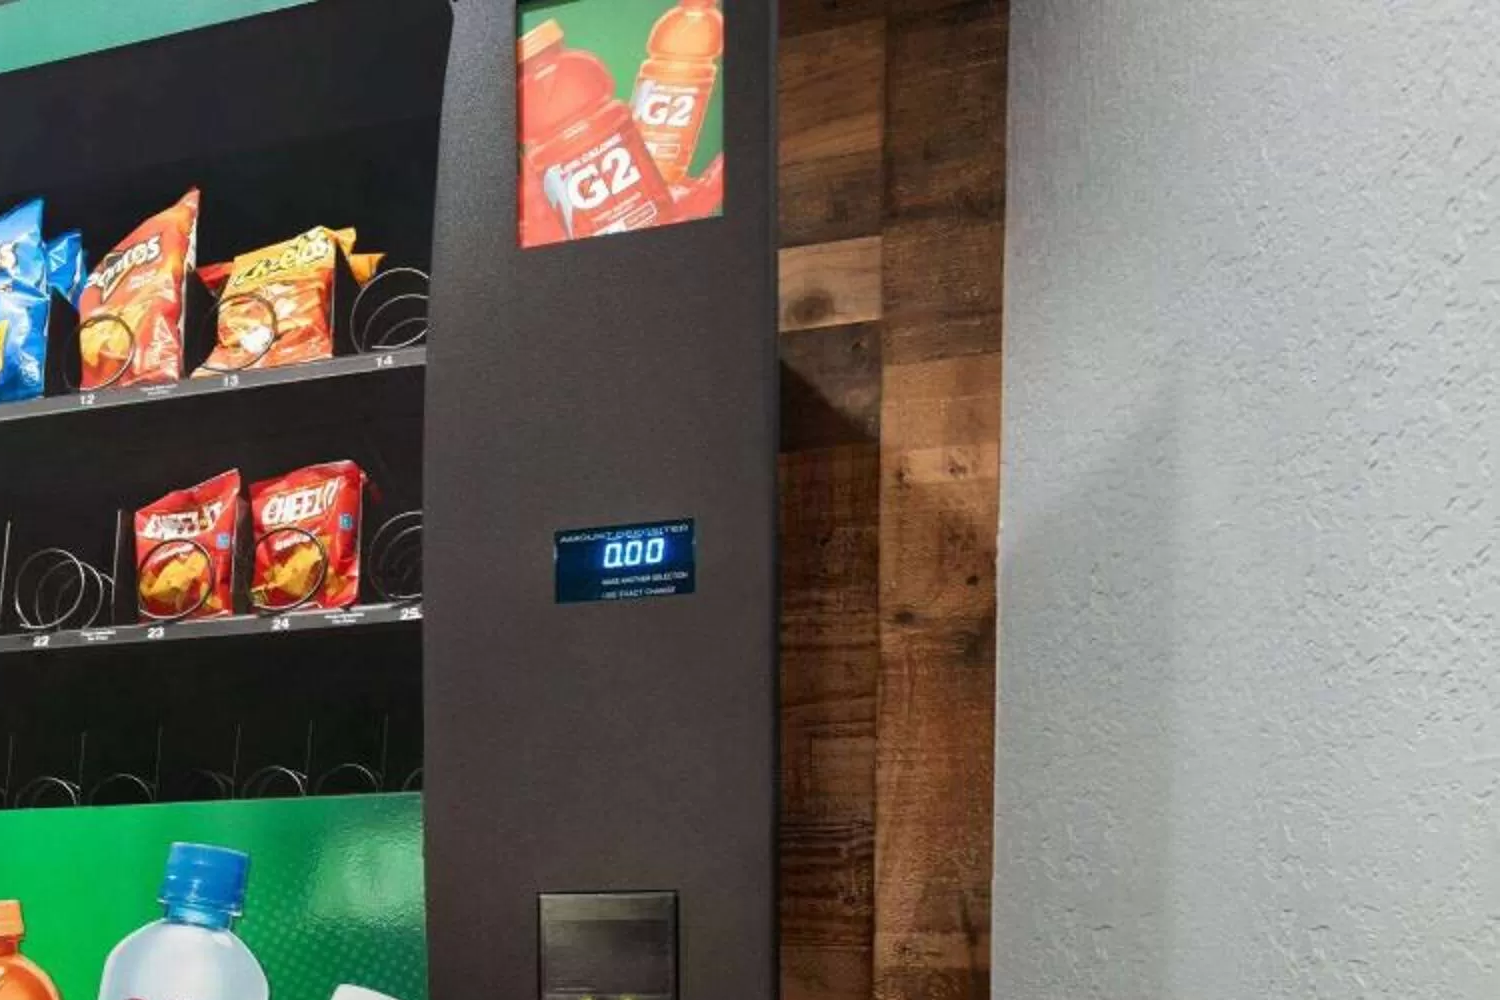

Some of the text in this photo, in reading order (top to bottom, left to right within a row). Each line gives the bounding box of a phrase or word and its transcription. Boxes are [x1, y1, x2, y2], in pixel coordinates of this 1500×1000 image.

[641, 94, 696, 126] G2
[567, 146, 642, 210] G2
[376, 355, 393, 367] 14
[223, 375, 238, 387] 13
[80, 394, 96, 405] 12
[603, 537, 665, 568] 0.00
[272, 618, 290, 630] 24
[148, 627, 164, 639] 23
[33, 635, 49, 647] 22
